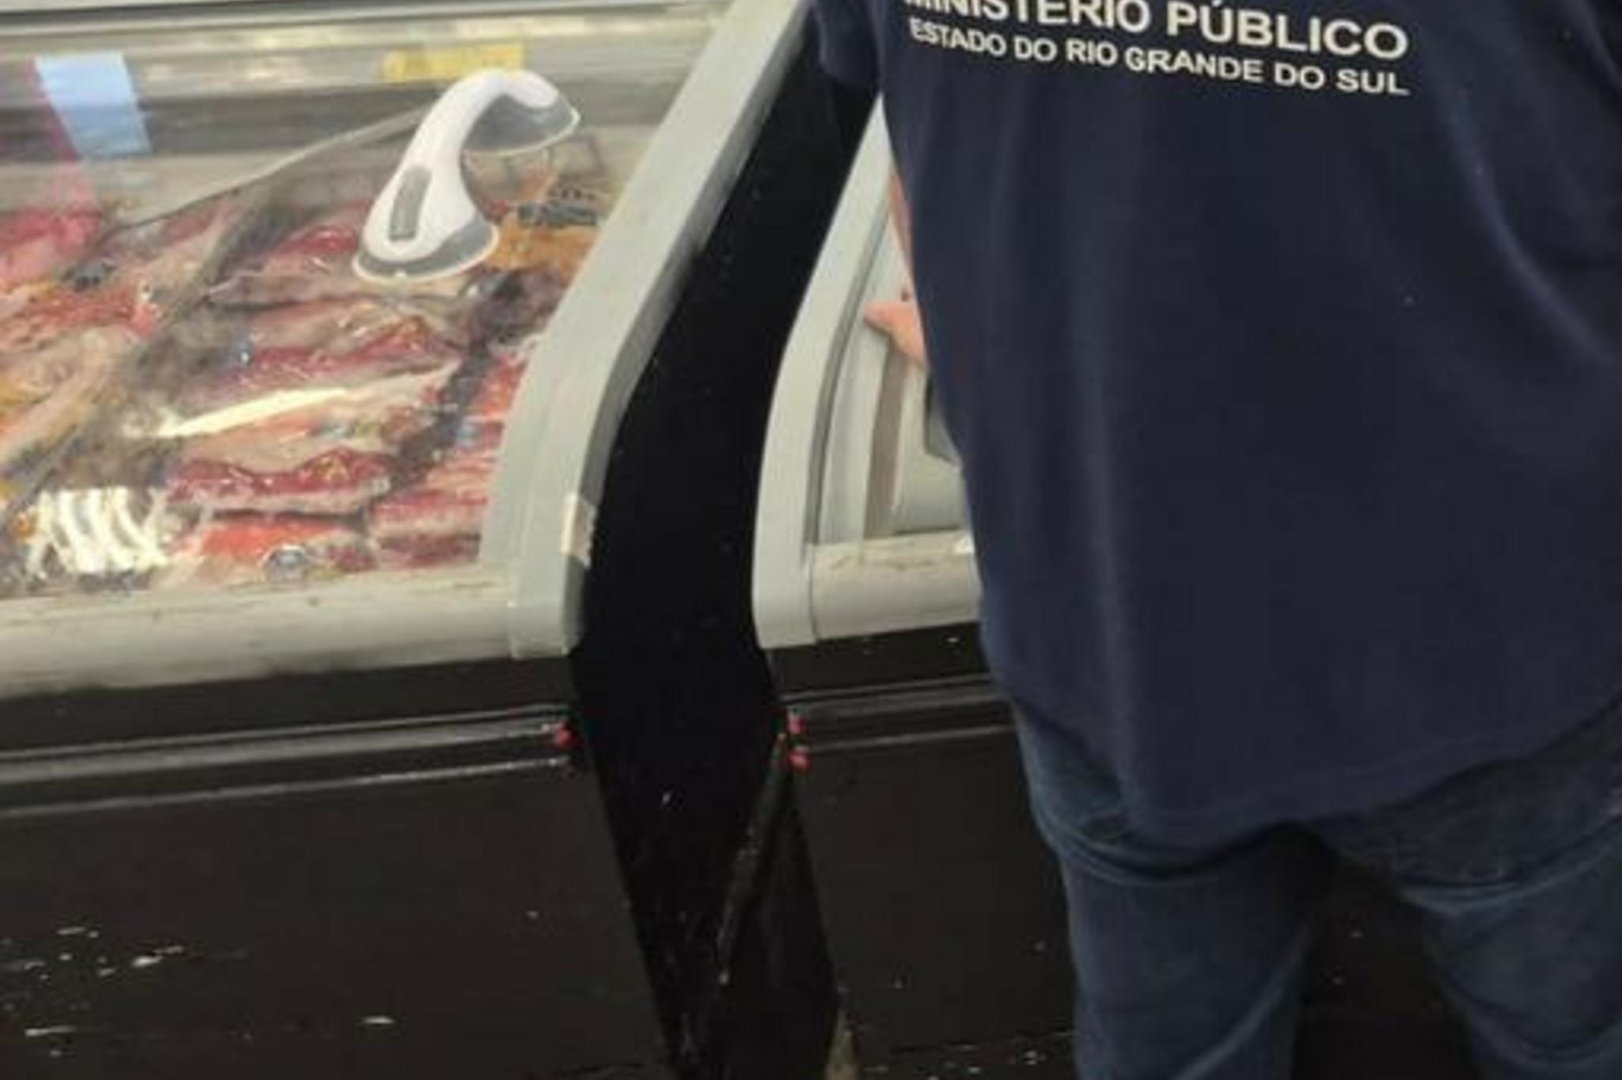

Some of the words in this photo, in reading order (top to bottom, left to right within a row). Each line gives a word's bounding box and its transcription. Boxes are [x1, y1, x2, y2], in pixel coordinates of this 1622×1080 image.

[908, 17, 1007, 57] ESTADO
[1013, 35, 1058, 62] DO
[1065, 38, 1118, 67] RIO
[1124, 45, 1265, 83] GRANDE
[1273, 62, 1326, 91] DO
[1335, 69, 1410, 96] SUL
